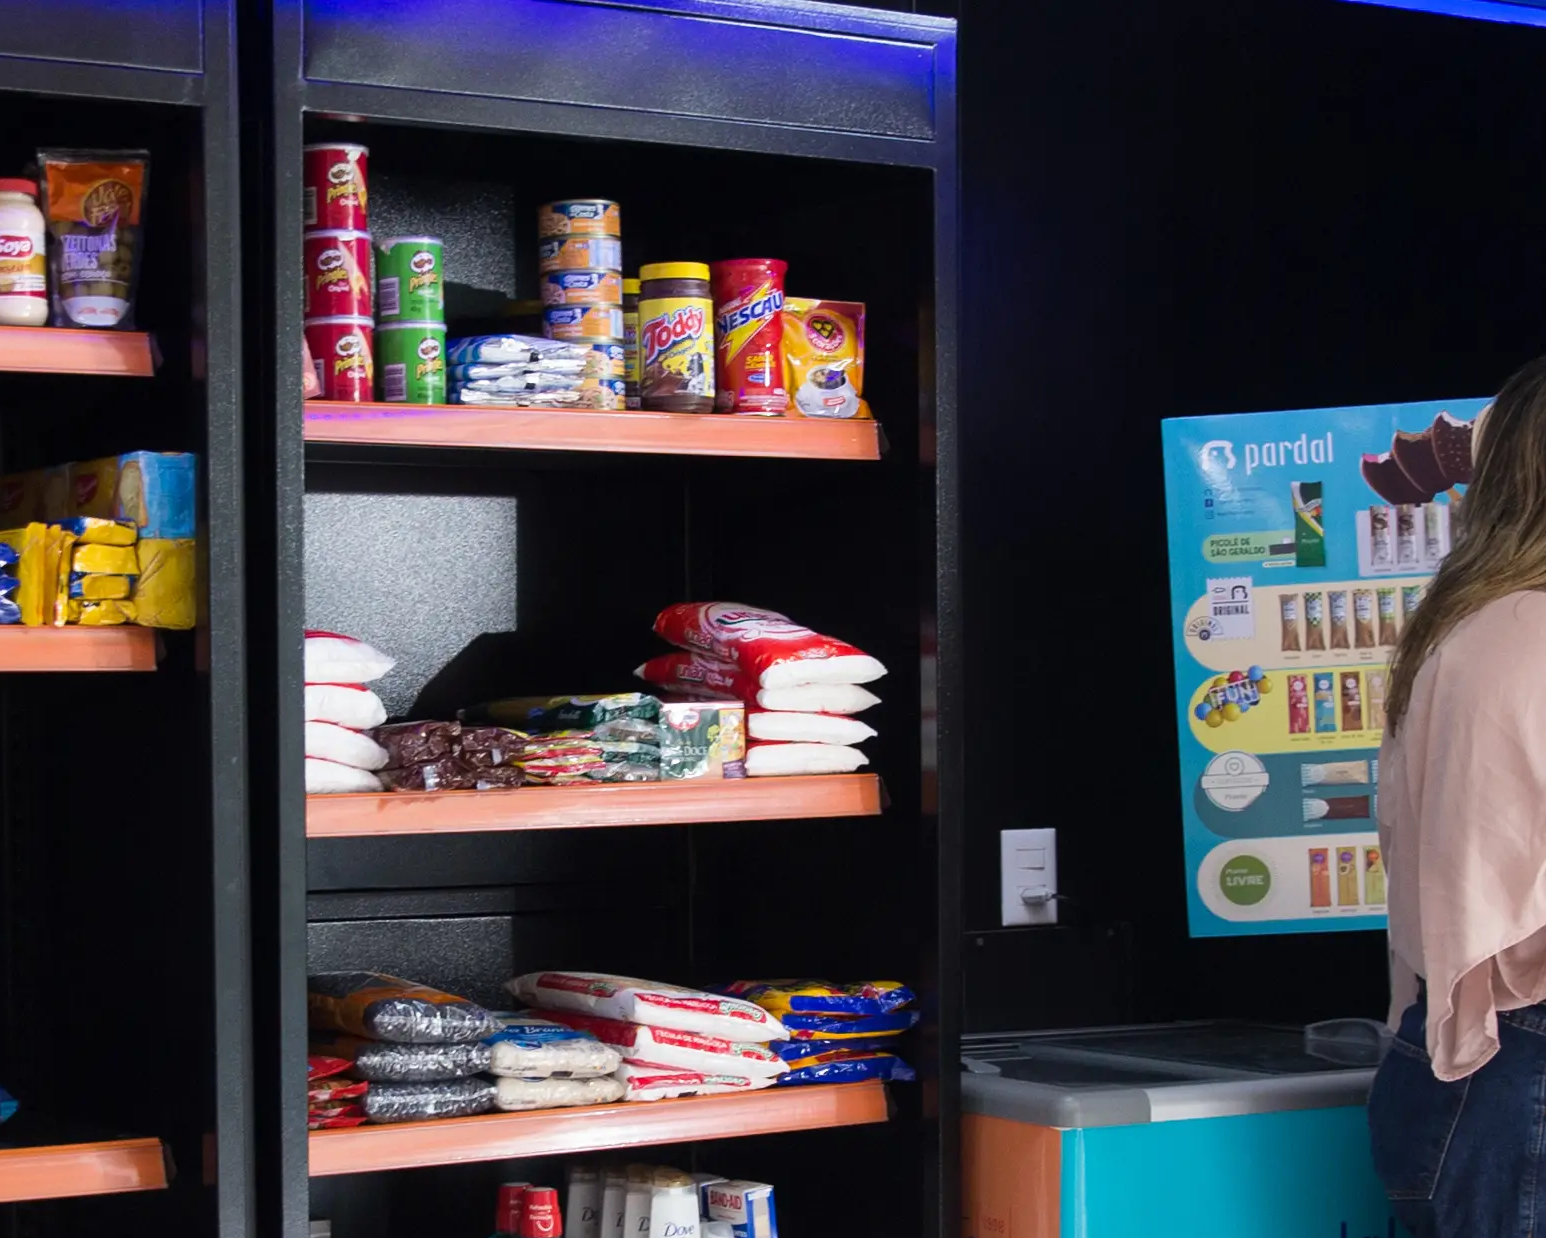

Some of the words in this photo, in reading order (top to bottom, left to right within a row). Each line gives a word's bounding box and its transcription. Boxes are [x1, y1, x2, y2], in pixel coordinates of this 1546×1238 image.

[60, 234, 117, 253] ZEITONAS
[717, 291, 785, 335] NESCAU
[642, 306, 704, 364] Toddy
[1244, 431, 1334, 476] pardal
[1210, 537, 1237, 547] PICOLÉ
[1240, 537, 1250, 547] DE
[1232, 545, 1266, 556] GERALDO
[1212, 603, 1250, 616] ORIGINAL
[708, 1189, 743, 1211] BAND-AID
[663, 1221, 695, 1238] Dove
